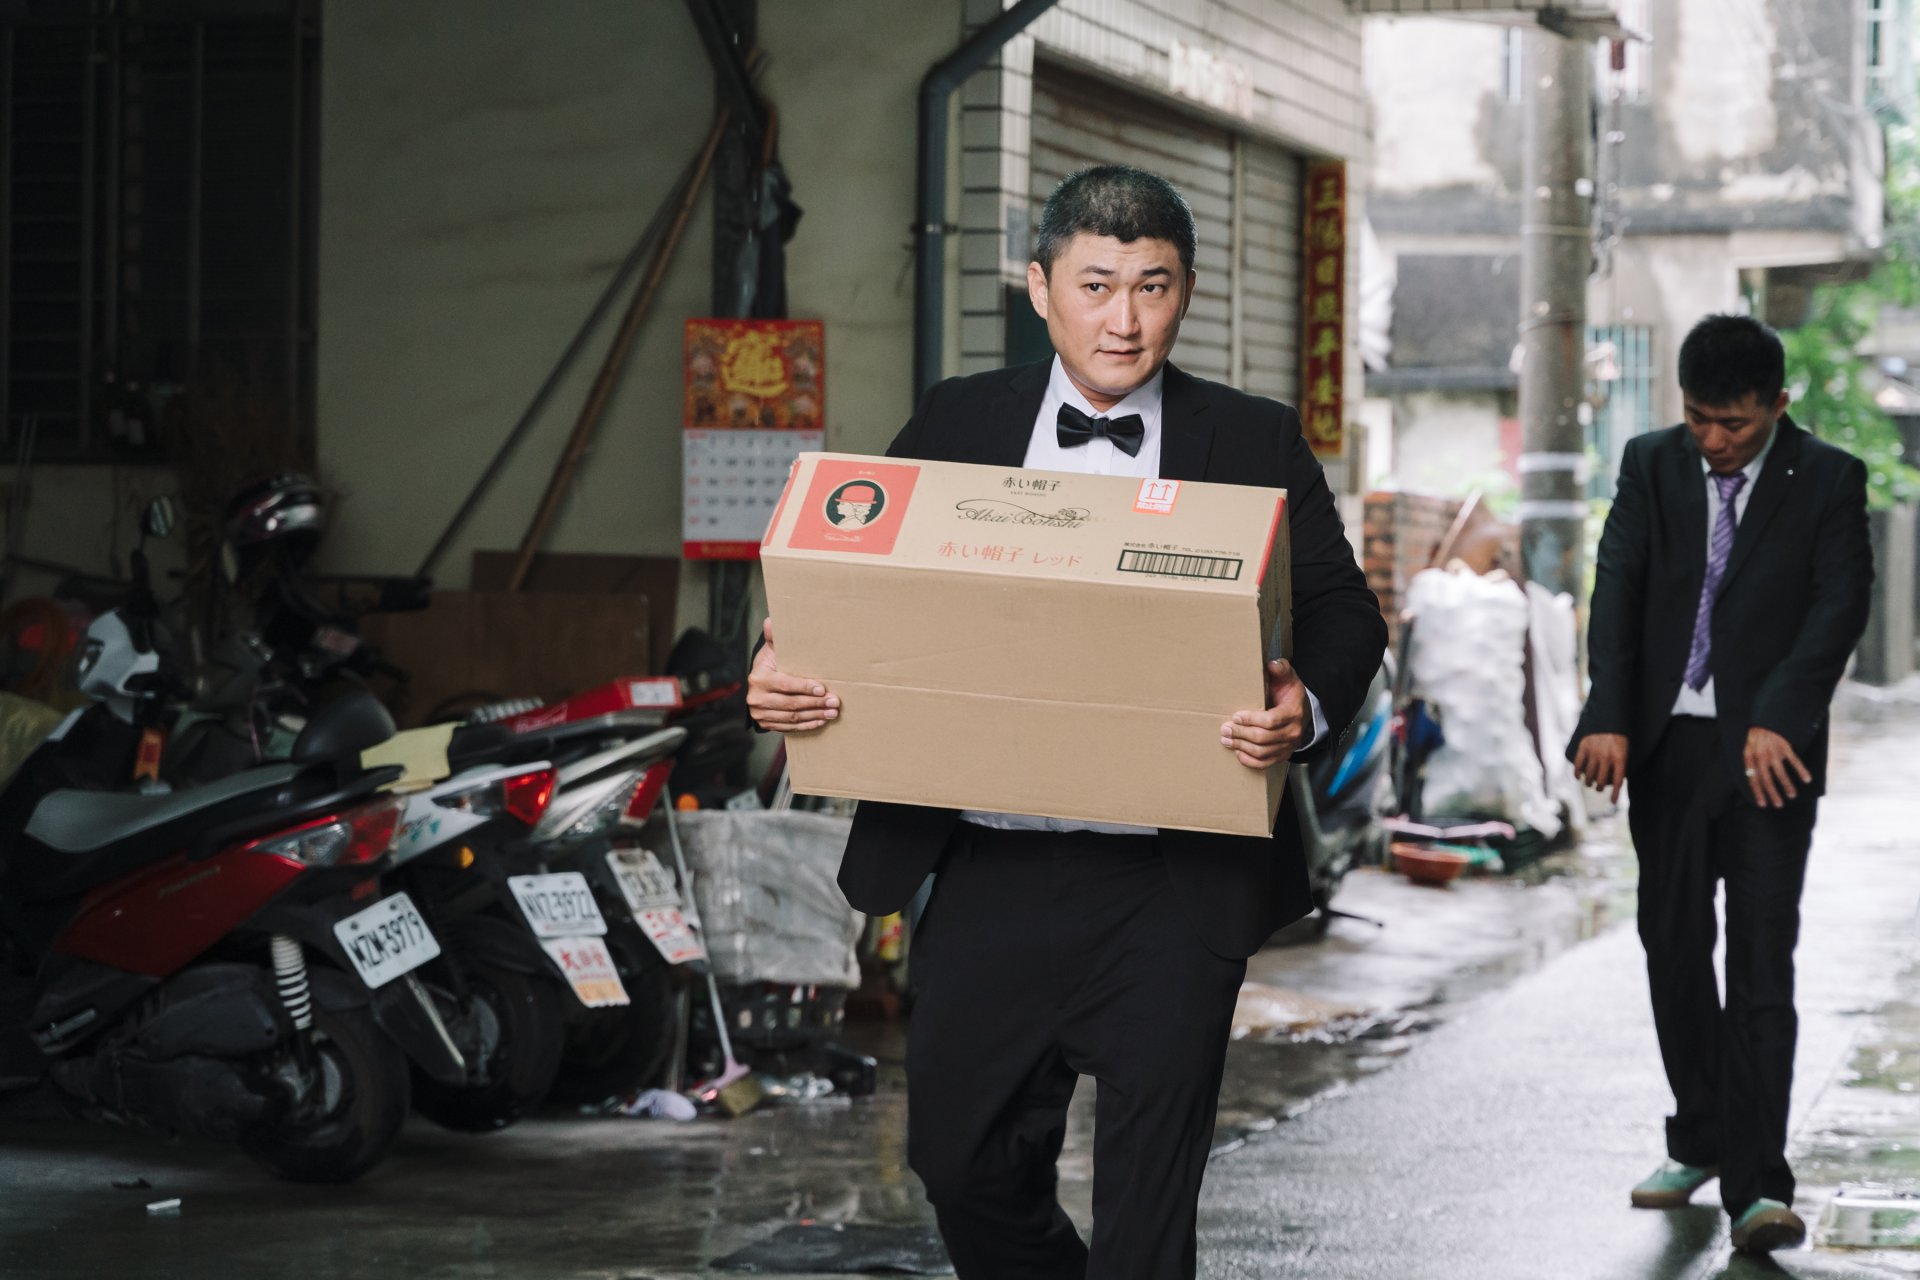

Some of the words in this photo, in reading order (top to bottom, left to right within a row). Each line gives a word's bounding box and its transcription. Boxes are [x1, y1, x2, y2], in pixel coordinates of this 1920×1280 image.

[1002, 476, 1061, 492] 赤い帽子
[938, 541, 1024, 563] 赤い帽子
[1032, 552, 1082, 567] レッド
